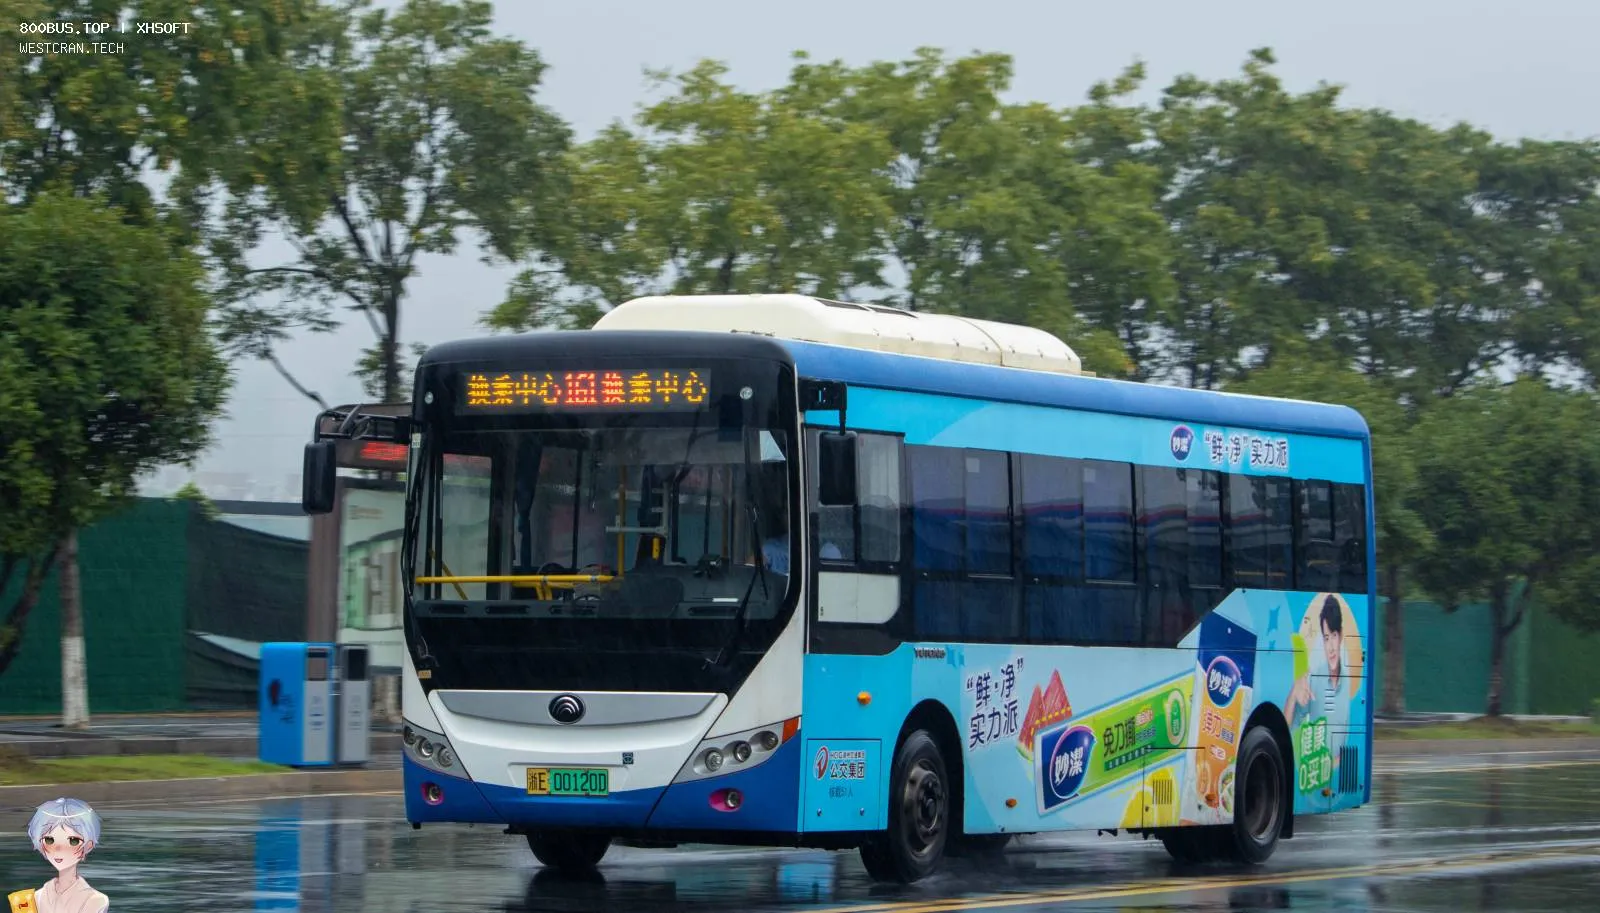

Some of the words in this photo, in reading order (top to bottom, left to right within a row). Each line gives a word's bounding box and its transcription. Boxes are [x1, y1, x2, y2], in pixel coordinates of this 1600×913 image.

[969, 699, 1018, 749] 实力派
[830, 762, 865, 778] 公交集团
